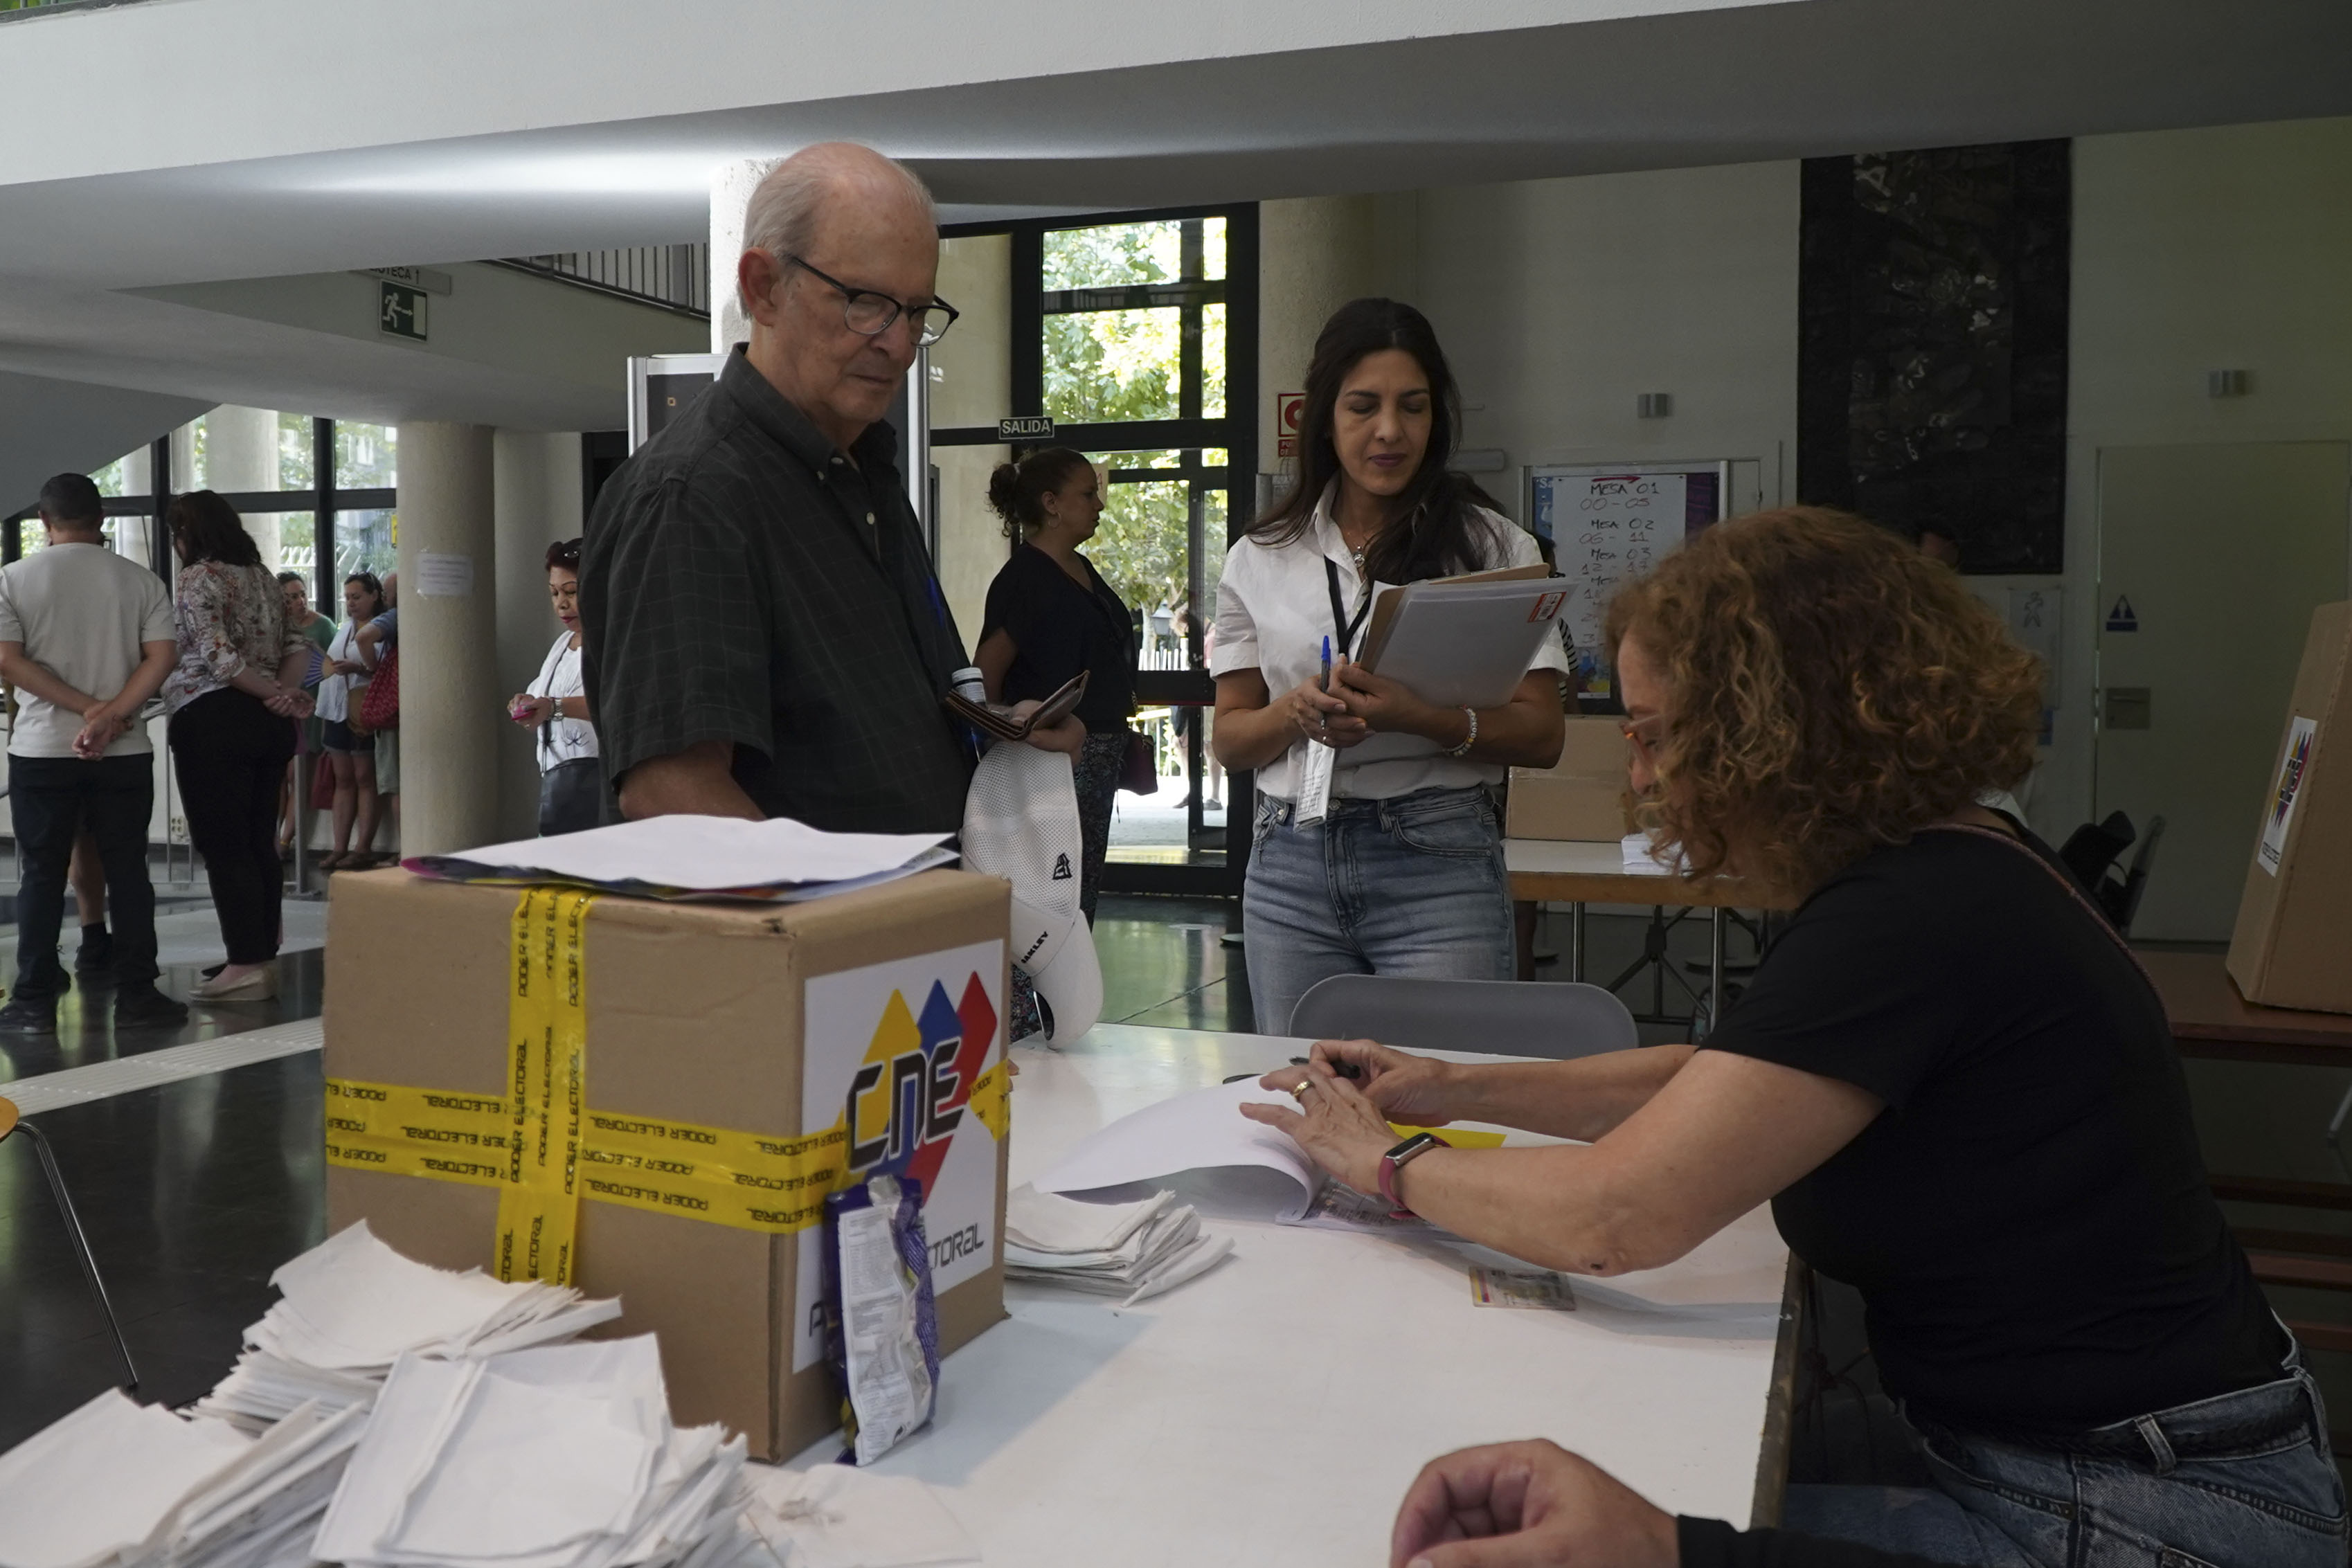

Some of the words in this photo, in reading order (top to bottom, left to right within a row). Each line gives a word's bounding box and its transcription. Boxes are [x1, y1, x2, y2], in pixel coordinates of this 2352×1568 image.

[1002, 419, 1051, 434] SALIDA
[1591, 483, 1628, 496] MESA
[1637, 482, 1660, 494] 01
[1580, 498, 1607, 510] 00
[1626, 498, 1650, 509] 05
[1629, 517, 1655, 530] 02
[1579, 532, 1604, 544] 06
[1628, 532, 1649, 543] 11
[1627, 547, 1651, 560] 03
[1581, 563, 1602, 575] 12
[518, 944, 528, 998] PODER
[568, 953, 578, 1007] PODER
[514, 1038, 527, 1126] ELECTORAL
[343, 1087, 387, 1101] PODER
[422, 1094, 501, 1113] ELECTORAL
[845, 1038, 964, 1172] CNE
[400, 1126, 479, 1145] ELECTORAL
[589, 1116, 665, 1137] ELECTORAL
[538, 1112, 548, 1167] PODER
[670, 1128, 717, 1145] PODER
[343, 1148, 387, 1163] PODER
[754, 1137, 819, 1156] ELECTORAL
[511, 1129, 523, 1184] PODER
[582, 1149, 643, 1168] ELECTOR
[419, 1157, 497, 1178] ELECTORAL
[564, 1140, 577, 1195] PODER
[644, 1159, 694, 1175] PODER
[584, 1178, 659, 1202] ELECTORAL
[731, 1172, 805, 1191] ELECTORAL
[662, 1193, 709, 1211] PODER
[501, 1227, 513, 1283] CTORAL
[528, 1214, 543, 1279] ECTORAL
[926, 1223, 984, 1270] TORAL
[556, 1240, 568, 1286] TORAL
